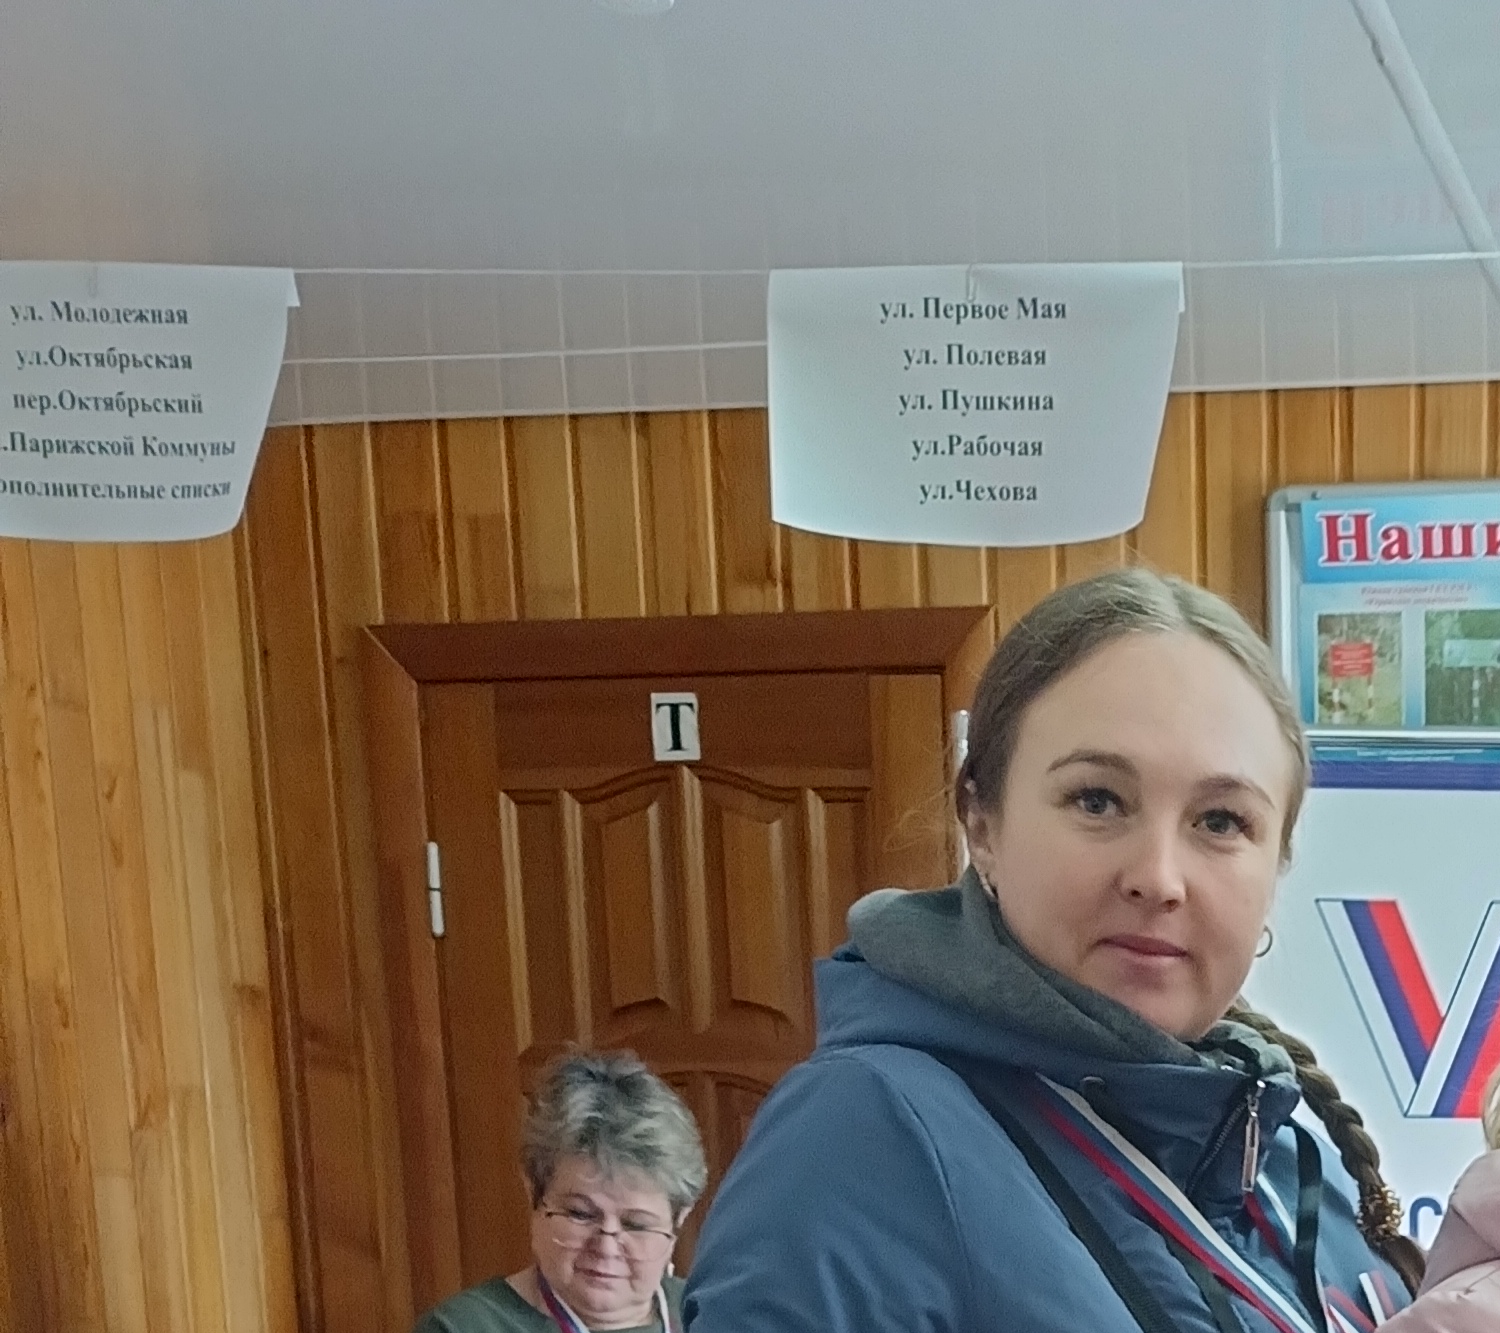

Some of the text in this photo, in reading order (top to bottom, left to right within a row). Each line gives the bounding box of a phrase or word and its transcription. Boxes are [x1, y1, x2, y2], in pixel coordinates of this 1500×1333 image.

[10, 300, 188, 325] ул. Молодежная
[879, 297, 1067, 325] ул. Первое Мая
[16, 345, 193, 373] ул.Октябрьская
[903, 344, 1047, 370] ул. Полевая
[12, 389, 204, 417] пер.Октябрьский
[898, 389, 1054, 416] ул. Пушкина
[0, 431, 236, 462] .Парижской Коммуны
[912, 434, 1043, 461] ул.Рабочая
[0, 479, 231, 499] ополнительные списки
[919, 480, 1037, 504] ул.Чехова
